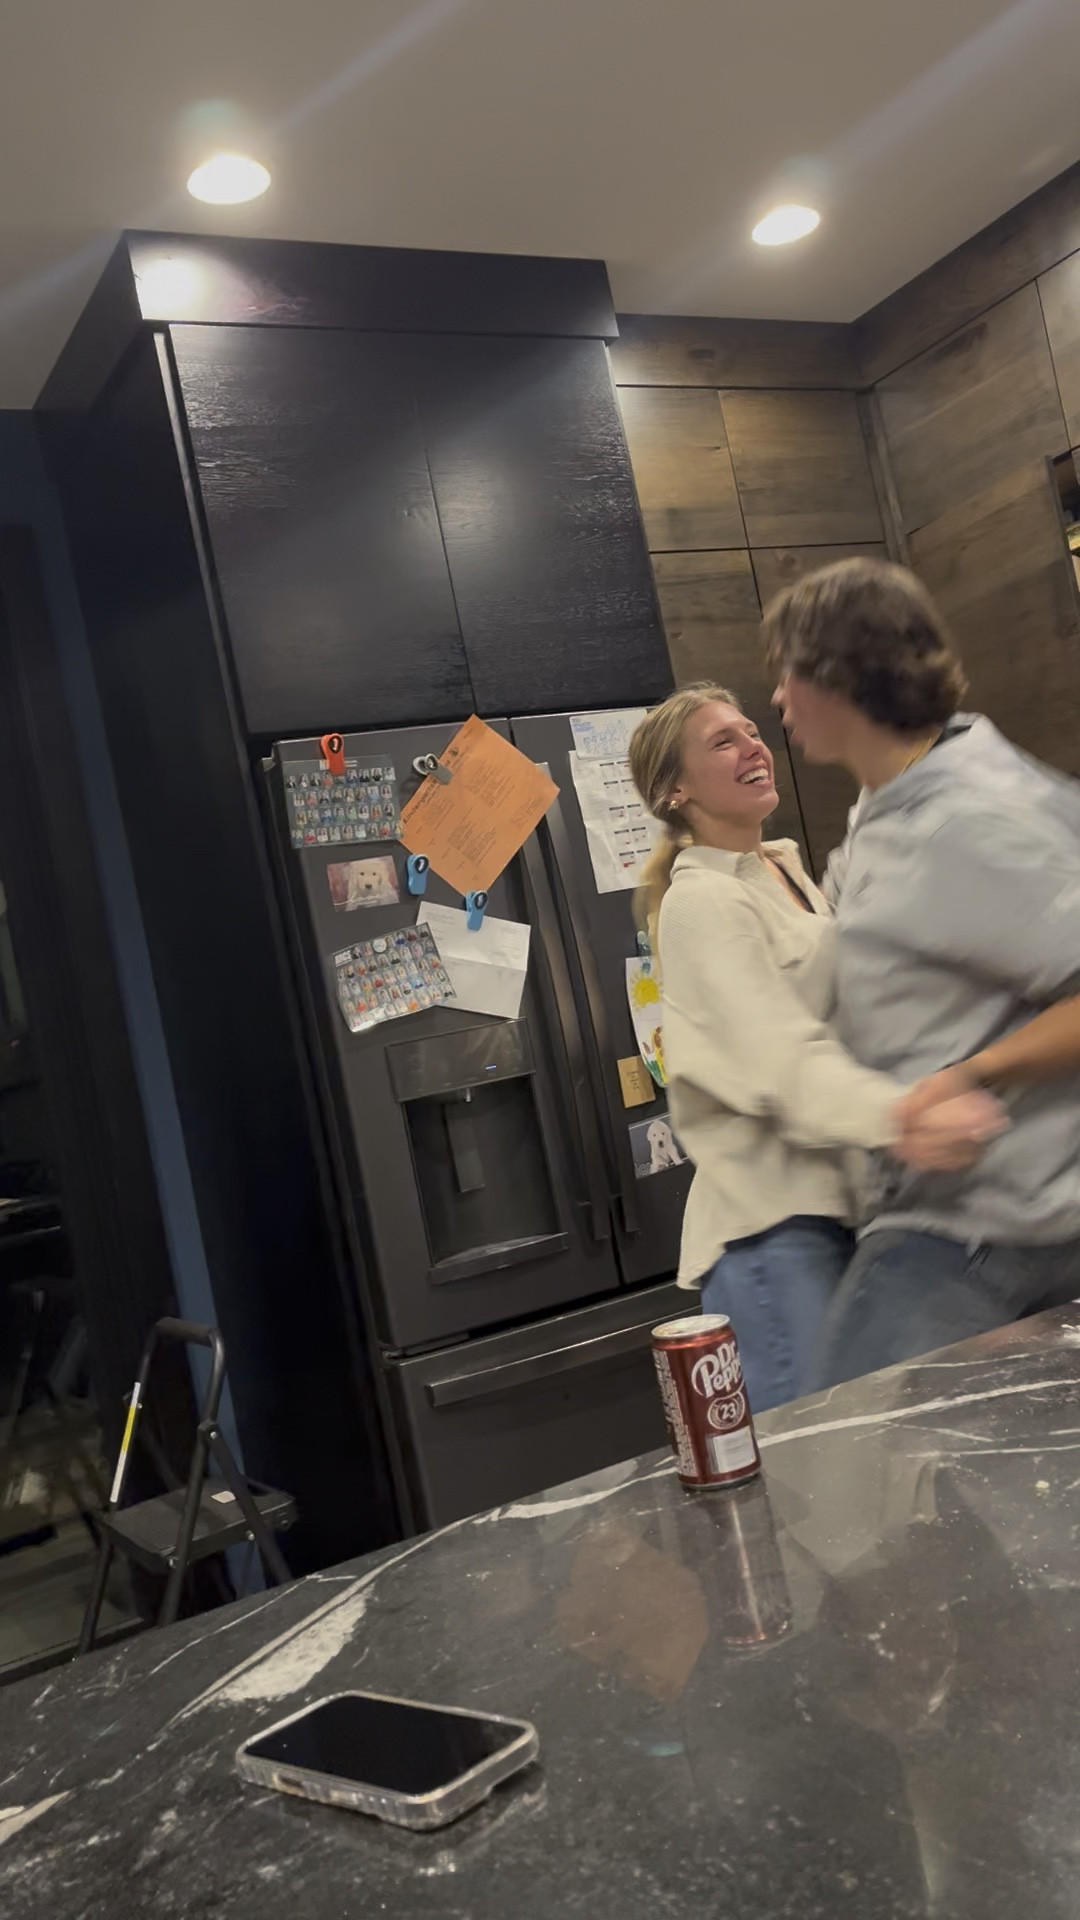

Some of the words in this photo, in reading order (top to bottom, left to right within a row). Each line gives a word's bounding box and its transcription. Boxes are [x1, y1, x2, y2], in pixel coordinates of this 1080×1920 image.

[717, 1341, 736, 1369] Dr
[691, 1352, 742, 1399] Pepp
[721, 1402, 737, 1420] 23
